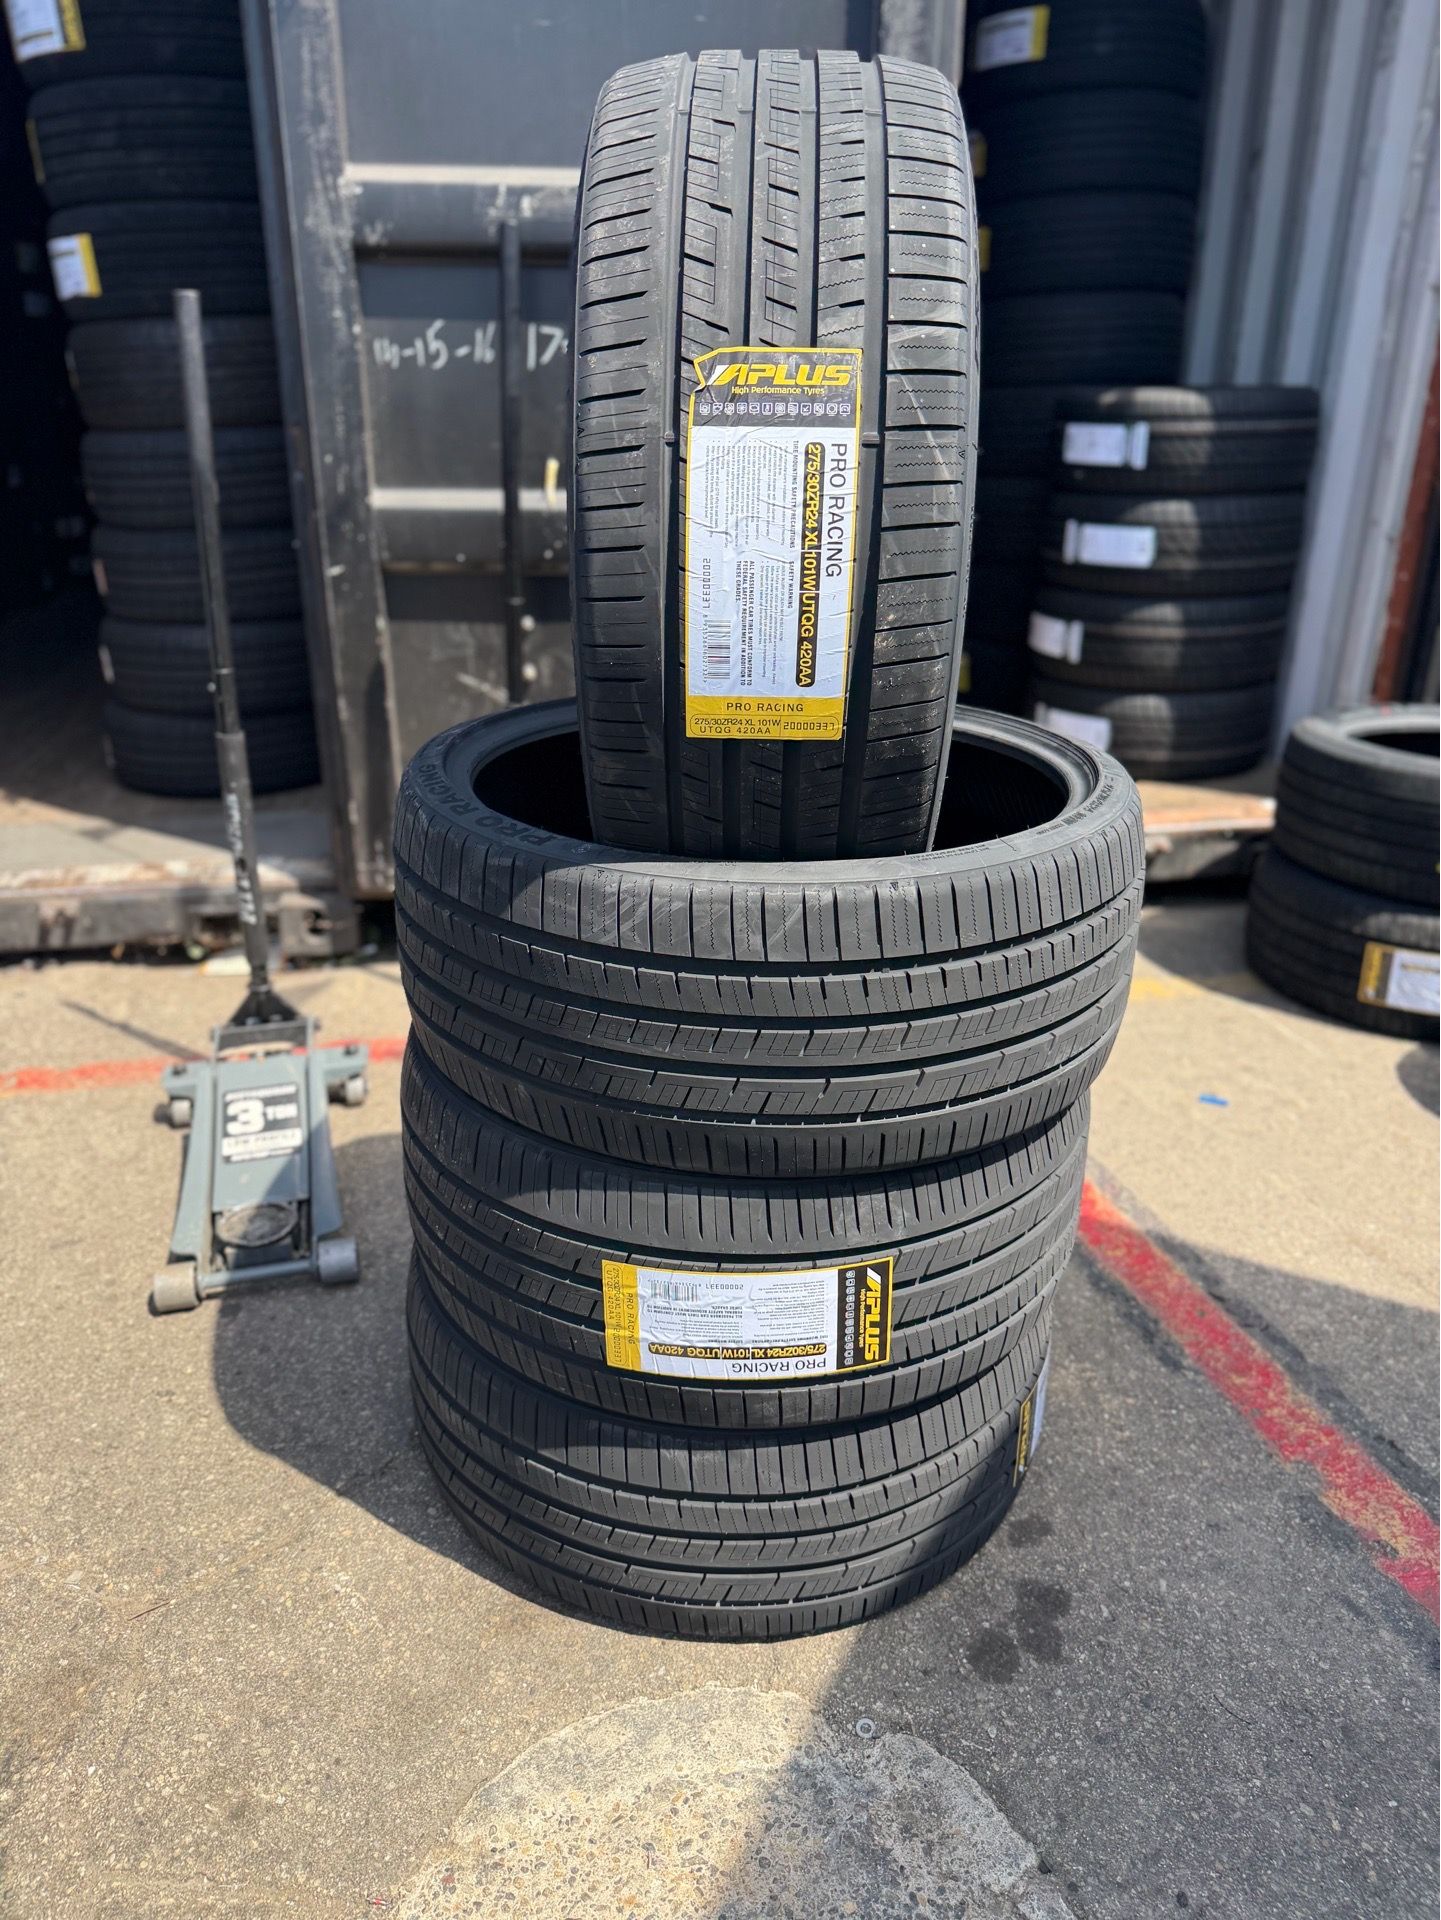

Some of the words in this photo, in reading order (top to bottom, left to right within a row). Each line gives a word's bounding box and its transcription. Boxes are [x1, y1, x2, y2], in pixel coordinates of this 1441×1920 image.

[708, 363, 853, 385] APLUS
[731, 386, 749, 395] High
[751, 386, 801, 395] Performance
[803, 386, 825, 396] Tyres
[791, 455, 799, 485] MOUNTING
[830, 443, 848, 488] PRO
[790, 486, 798, 508] SAFETY
[806, 444, 821, 529] 275/30ZR24
[789, 509, 797, 549] PRECAUTIONS
[826, 496, 846, 577] RACING
[804, 531, 818, 550] XL
[803, 551, 817, 590] 101W
[702, 558, 711, 609] 20000337
[801, 593, 815, 637] UTQG
[799, 641, 813, 686] 420AA
[726, 702, 752, 711] PRO
[757, 703, 804, 712] RACING
[694, 718, 743, 726] 275/30ZR24
[757, 719, 781, 727] 101W
[783, 721, 835, 731] 20000337
[699, 726, 731, 734] UTQG
[736, 727, 771, 735] 420AA
[418, 763, 479, 816] RACING
[474, 815, 560, 846] PRO
[226, 1099, 265, 1135] 3
[626, 1292, 634, 1310] PRO
[864, 1267, 881, 1361] APLUS
[627, 1312, 635, 1345] RACING
[650, 1344, 685, 1356] 420AA
[687, 1347, 720, 1358] UTQG
[722, 1348, 750, 1358] 101W
[751, 1348, 765, 1358] XL
[766, 1344, 826, 1357] 275/30ZR24
[731, 1361, 790, 1373] RACING
[795, 1357, 827, 1371] PRO
